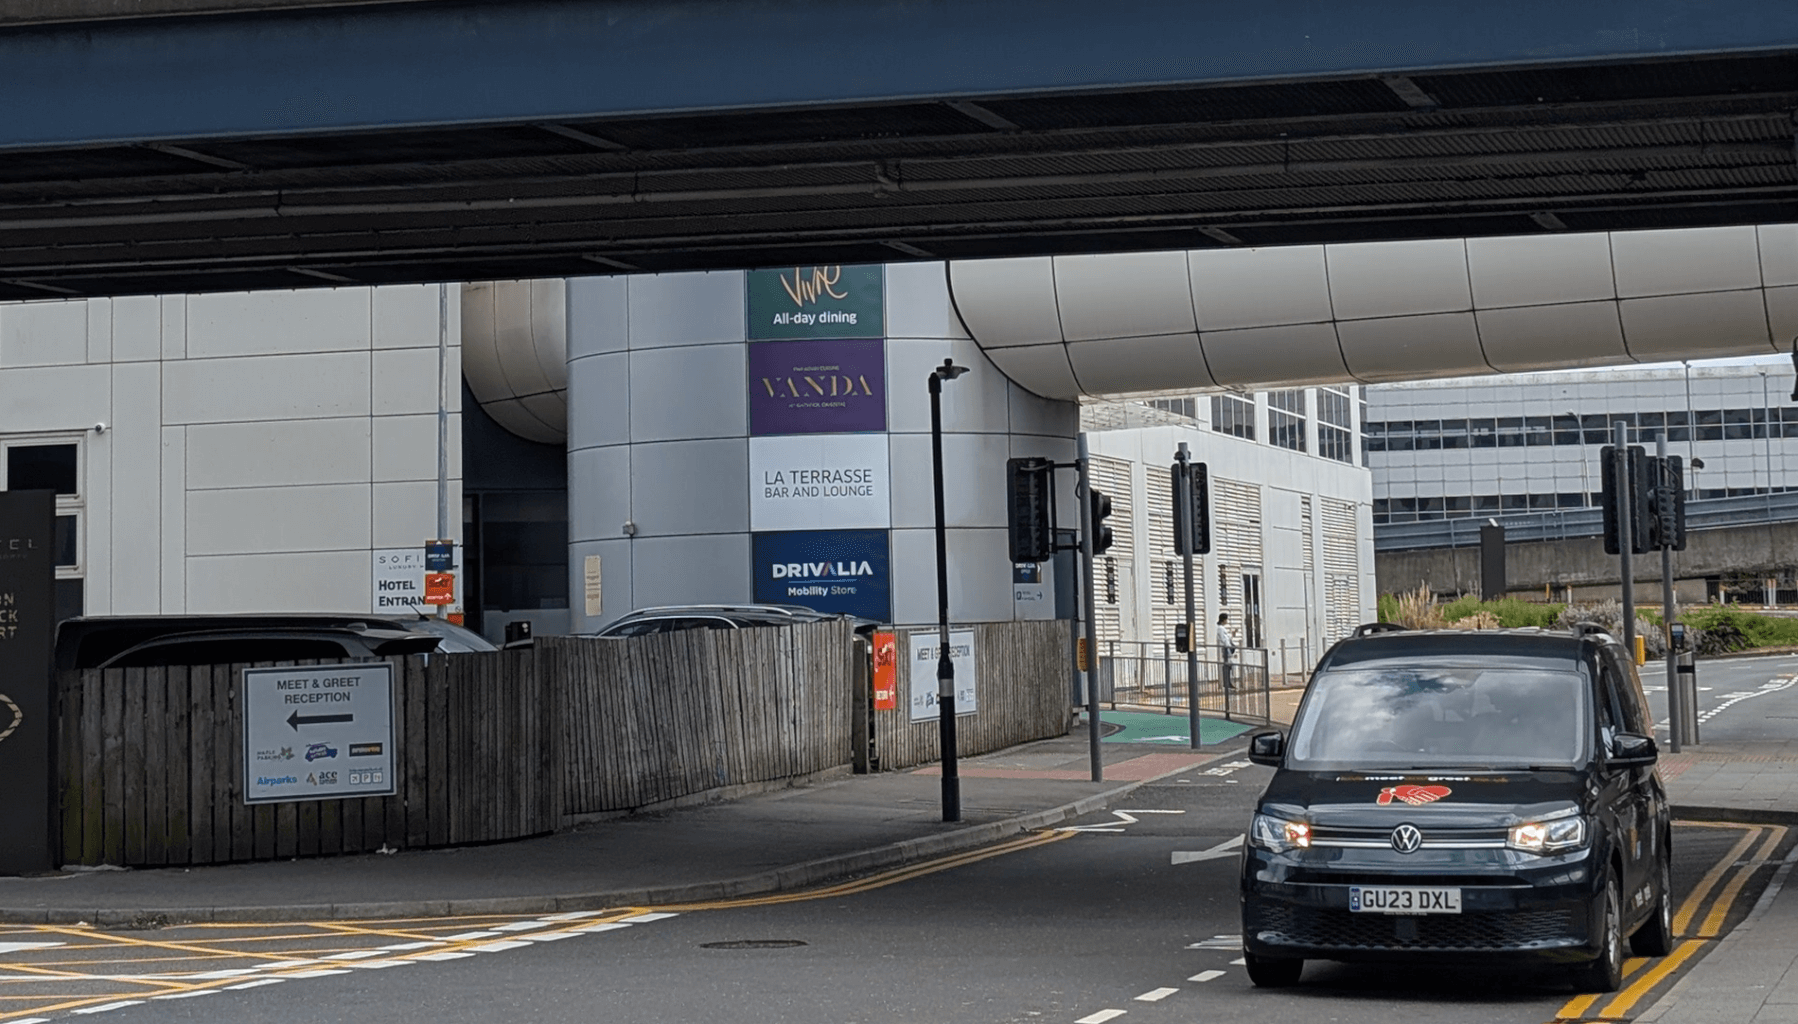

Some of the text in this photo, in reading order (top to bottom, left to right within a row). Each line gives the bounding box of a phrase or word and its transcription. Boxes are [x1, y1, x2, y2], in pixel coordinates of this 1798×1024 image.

[773, 310, 858, 326] All-day dining
[762, 374, 873, 398] VANDA
[764, 468, 873, 485] LA TERRASSE
[764, 484, 873, 498] BAR AND LOUNGE
[772, 560, 874, 578] DRIVALIA
[378, 579, 416, 591] HOTEL
[788, 584, 858, 598] Mobility Store
[276, 677, 361, 691] MEET & GREET
[284, 691, 351, 704] RECEPTION
[256, 775, 298, 787] Airparks
[319, 771, 338, 779] ace
[1362, 889, 1457, 911] GU23 DXL
